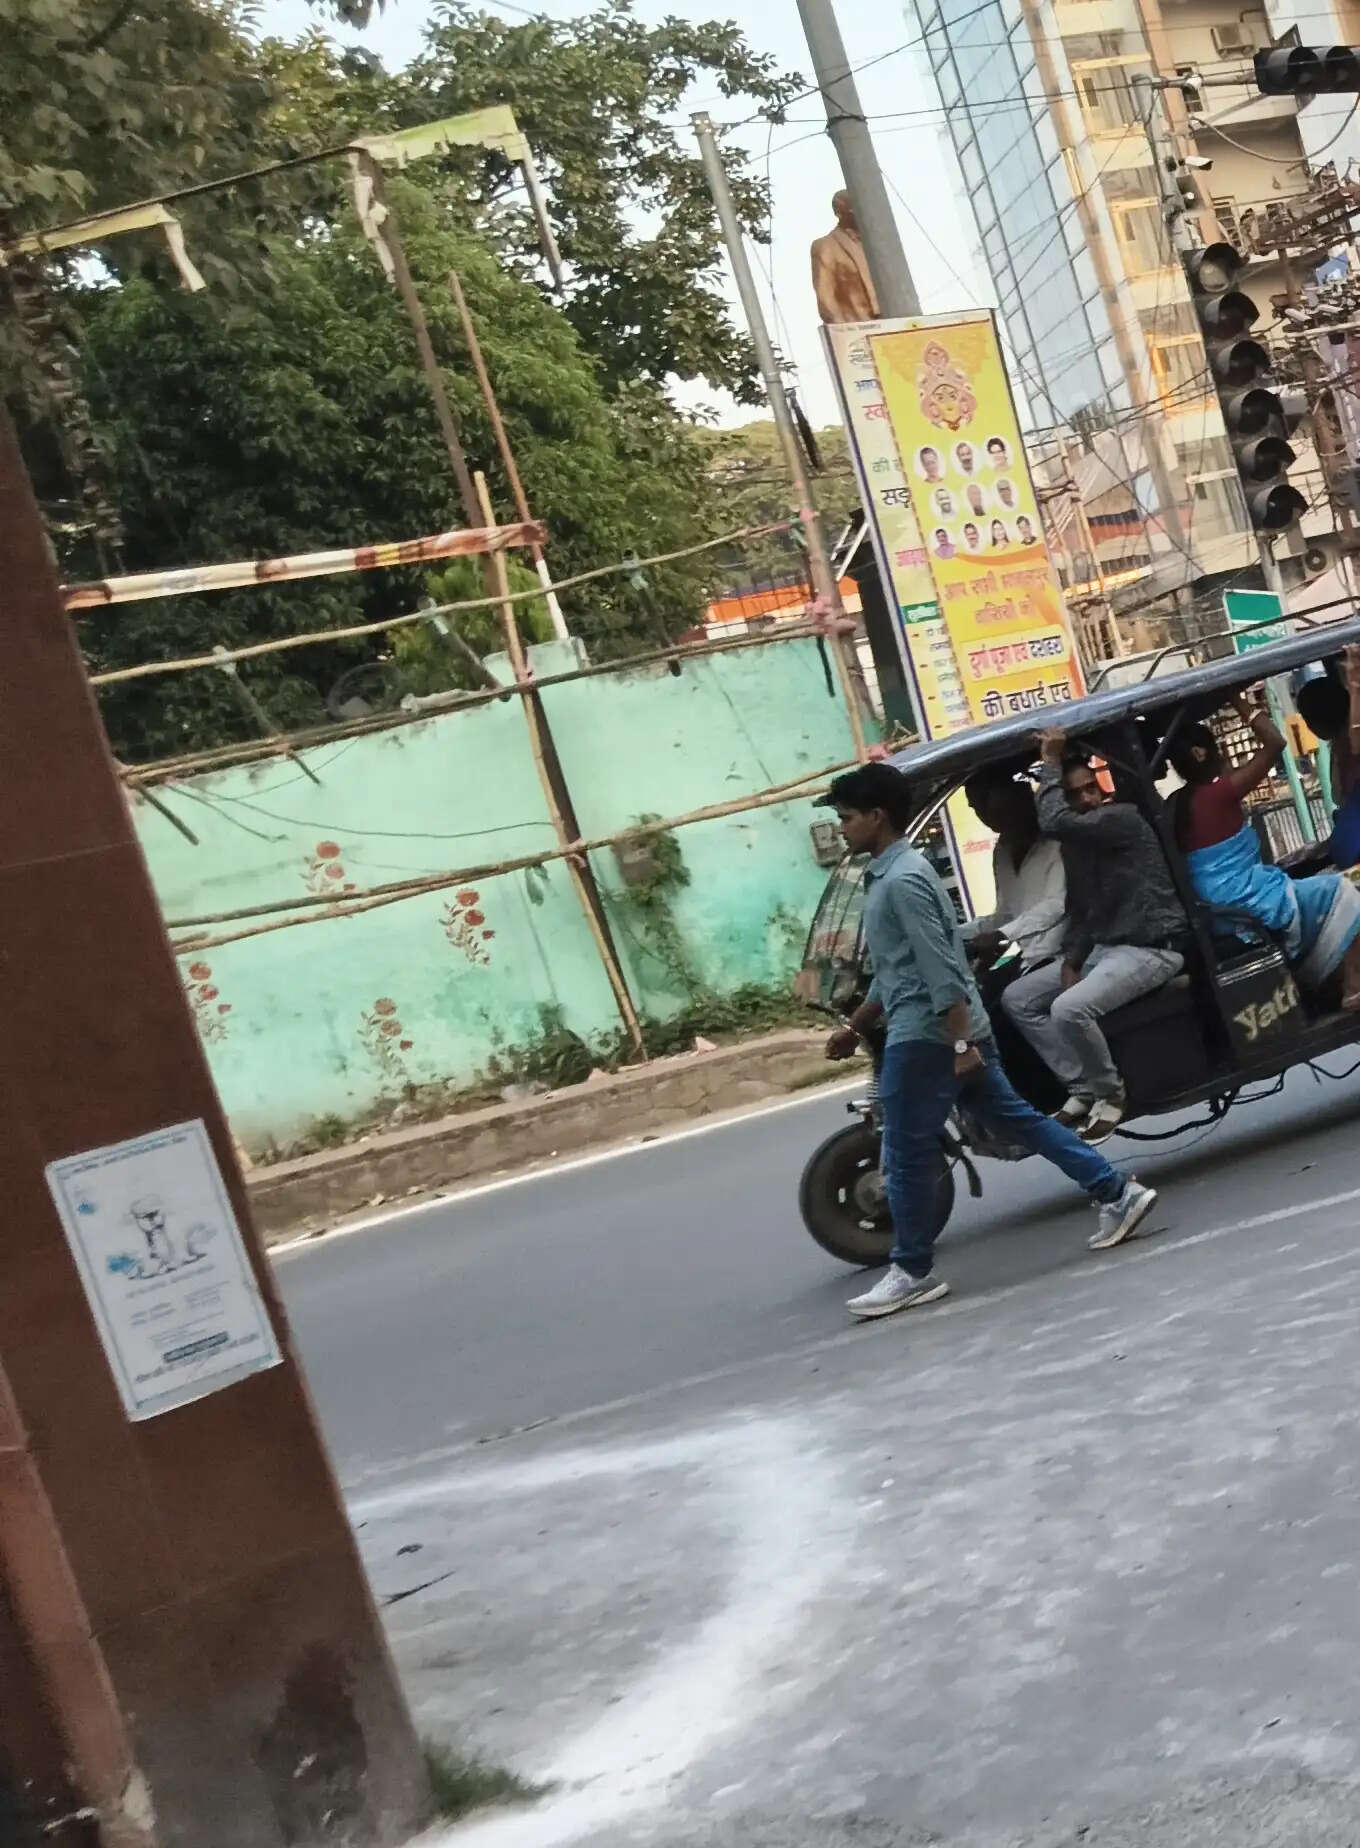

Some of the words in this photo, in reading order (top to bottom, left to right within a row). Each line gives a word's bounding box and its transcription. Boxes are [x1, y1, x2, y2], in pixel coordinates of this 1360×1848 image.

[981, 690, 1005, 717] की
[1006, 680, 1047, 711] बधाई
[1048, 676, 1072, 703] एवं
